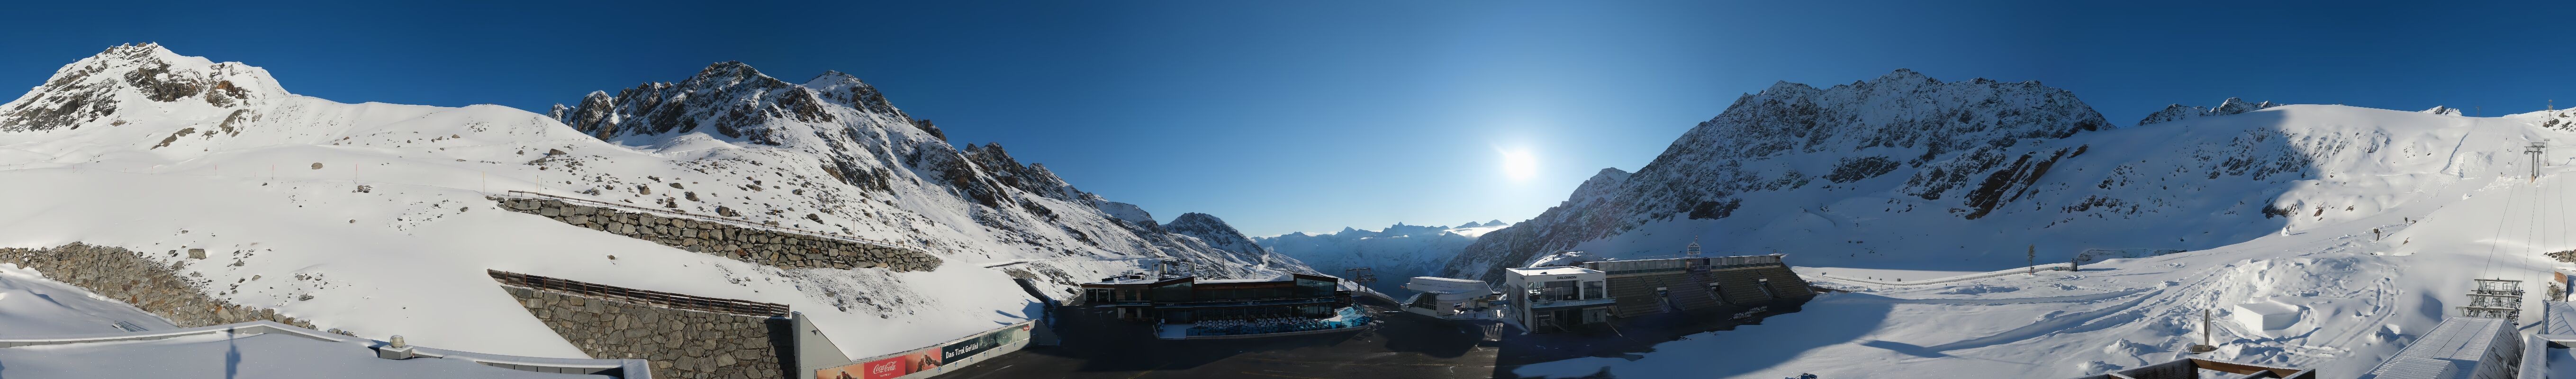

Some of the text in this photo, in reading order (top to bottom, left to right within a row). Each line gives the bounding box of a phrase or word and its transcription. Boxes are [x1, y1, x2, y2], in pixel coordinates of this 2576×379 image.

[946, 351, 954, 359] Das
[965, 343, 978, 353] Gefühl
[873, 361, 897, 374] Coca-Cola
